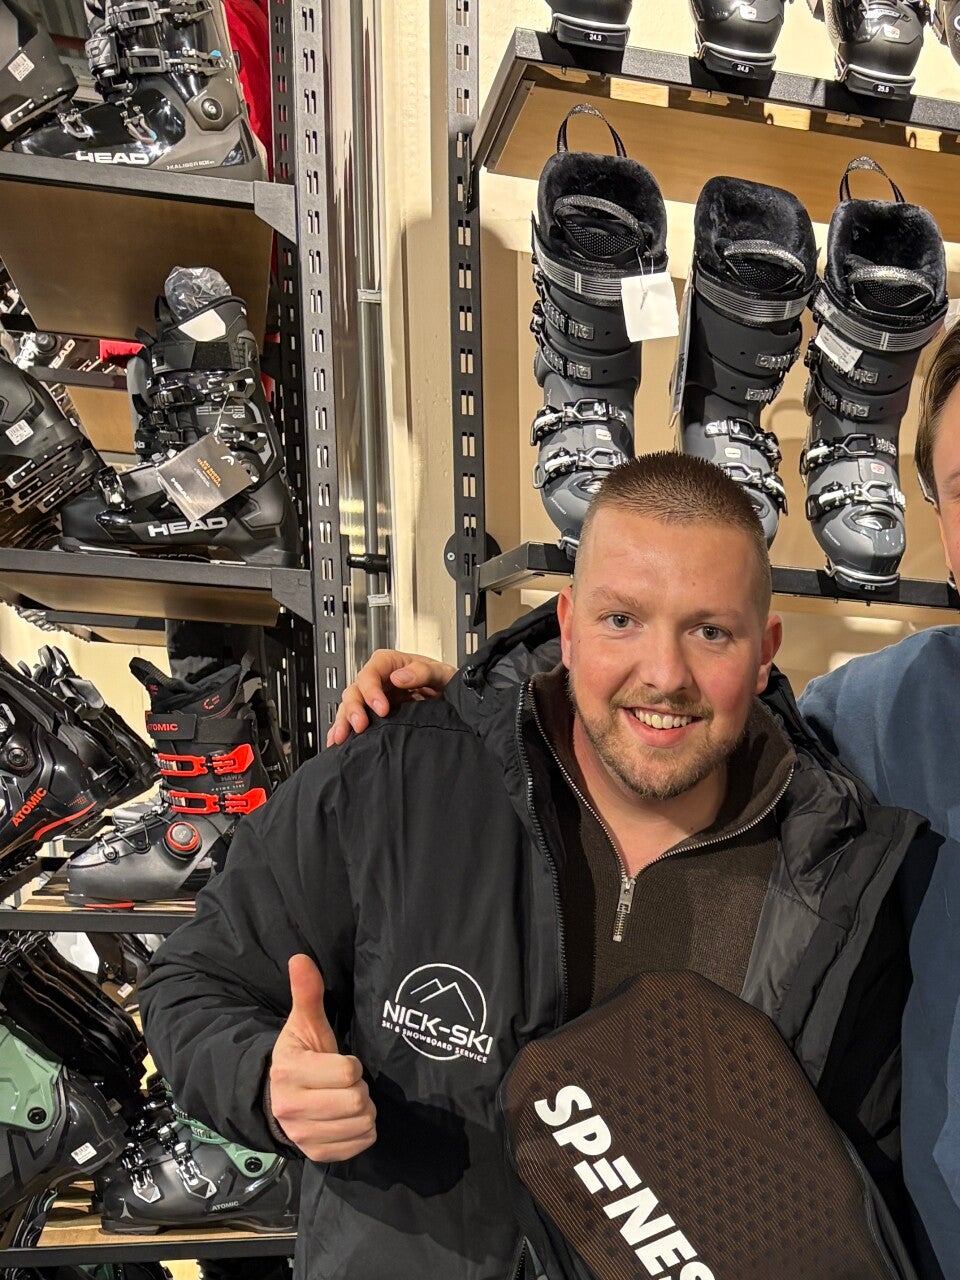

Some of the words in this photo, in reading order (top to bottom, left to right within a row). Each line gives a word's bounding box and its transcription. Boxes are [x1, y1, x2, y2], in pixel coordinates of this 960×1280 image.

[588, 33, 602, 42] 24.5
[736, 65, 749, 73] 24.5
[75, 152, 149, 165] HEAD
[147, 516, 228, 537] HEAD
[147, 723, 178, 732] TOMIC
[10, 786, 48, 828] ATOMIC
[382, 999, 494, 1055] NICK-SKI
[381, 1020, 393, 1030] SKI
[402, 1028, 453, 1052] SNOWBOARD
[454, 1046, 488, 1064] SERVICE
[211, 1200, 240, 1212] ATOMIC
